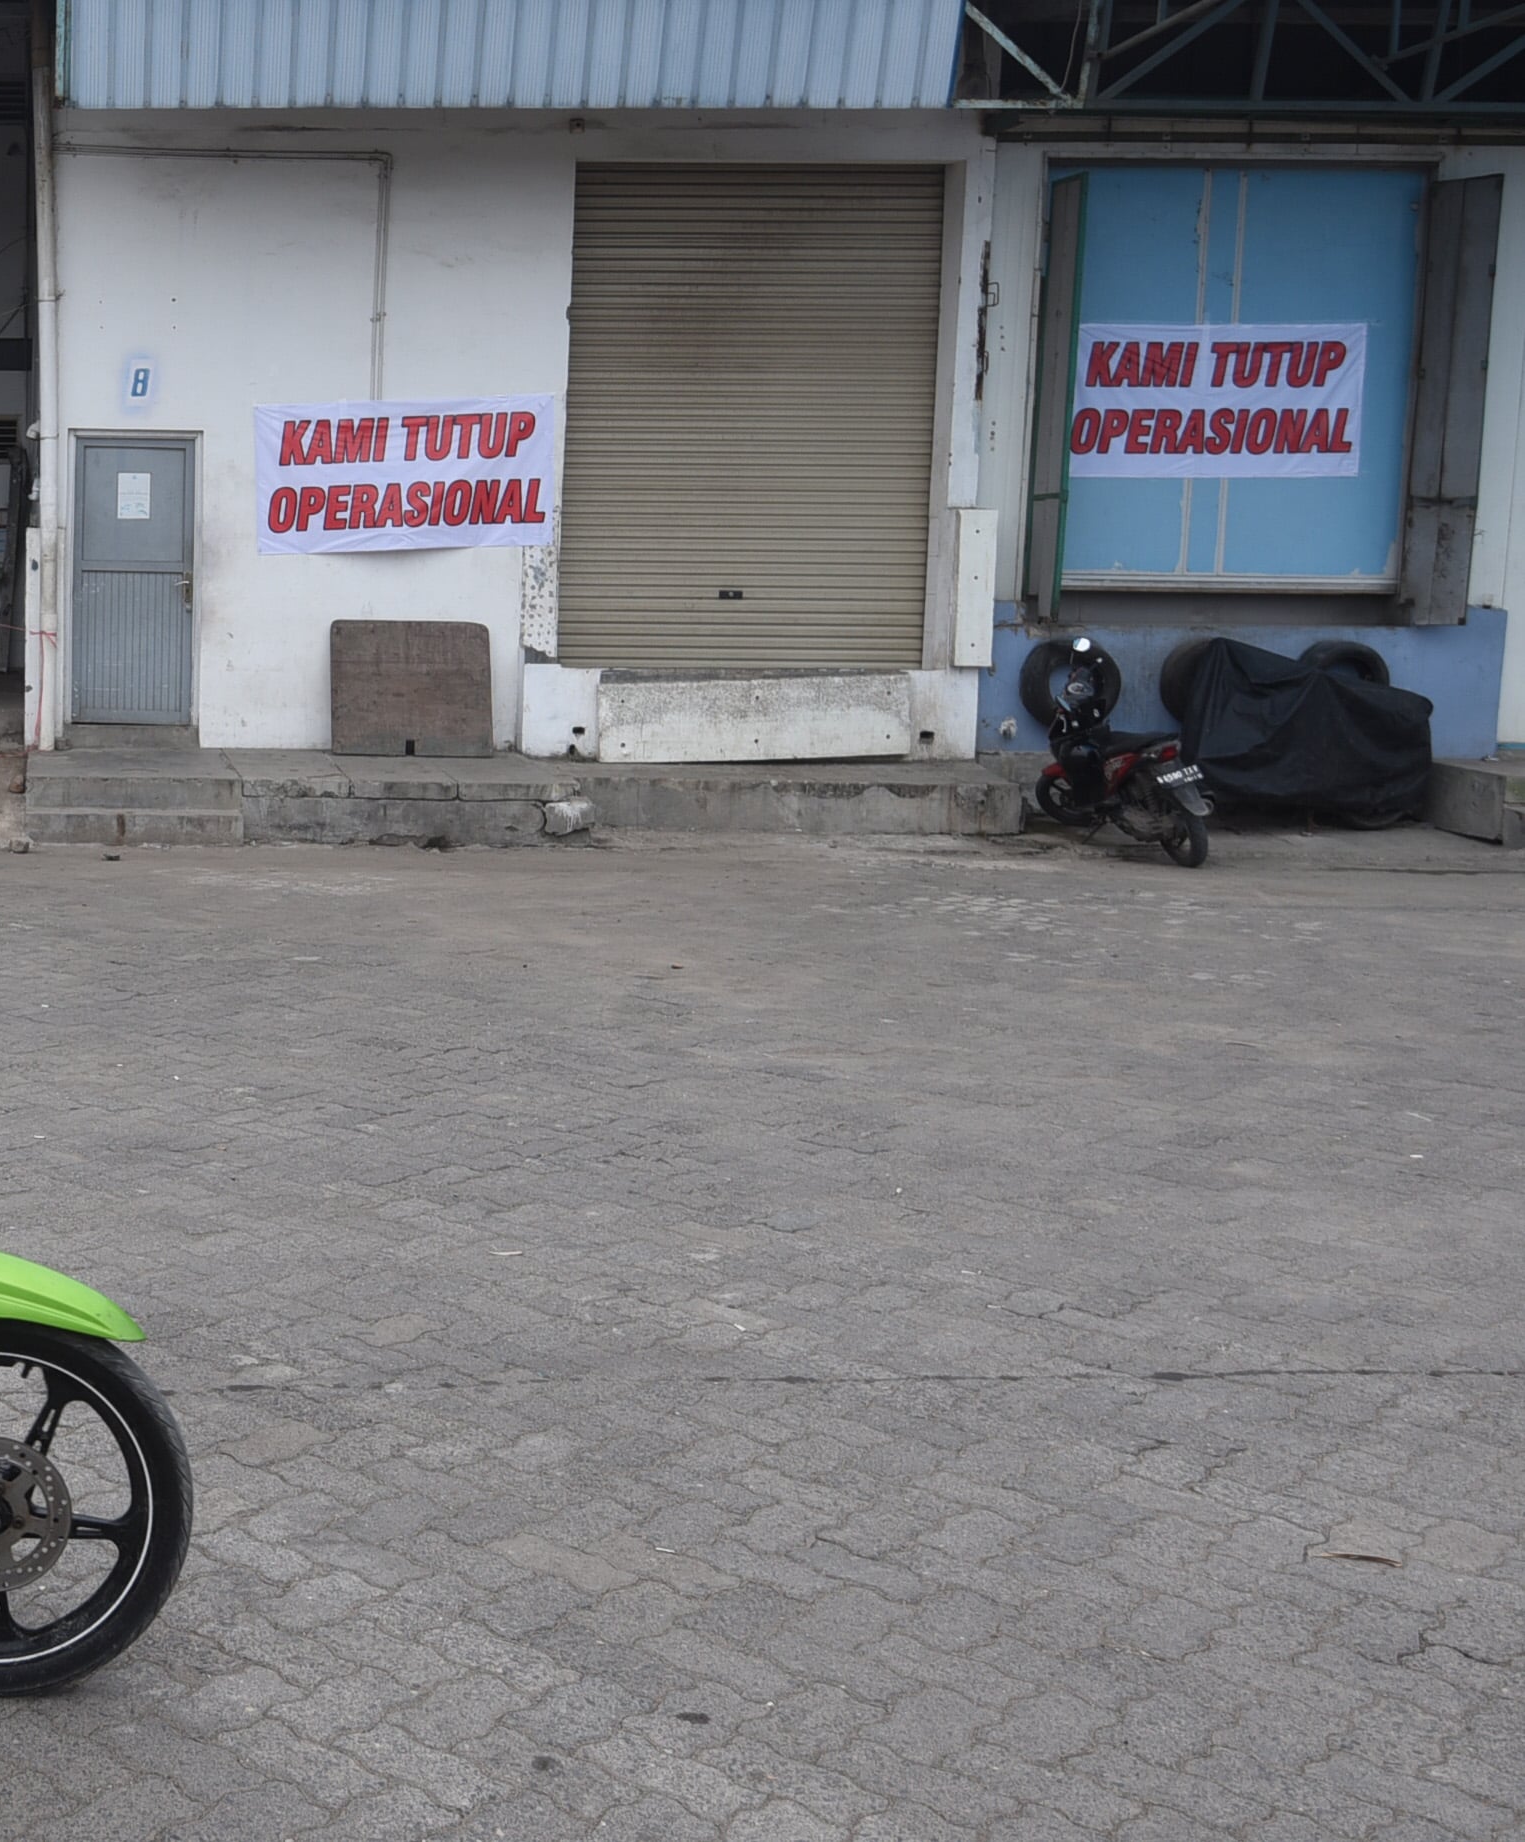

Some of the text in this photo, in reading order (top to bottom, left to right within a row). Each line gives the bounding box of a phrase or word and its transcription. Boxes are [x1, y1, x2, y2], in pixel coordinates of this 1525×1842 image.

[130, 367, 151, 397] 8
[1085, 341, 1347, 388] KAMI TUTUP
[279, 411, 536, 466] KAMI TUTUP
[1069, 408, 1352, 455] OPERASIONAL
[267, 477, 546, 534] OPERASIONAL
